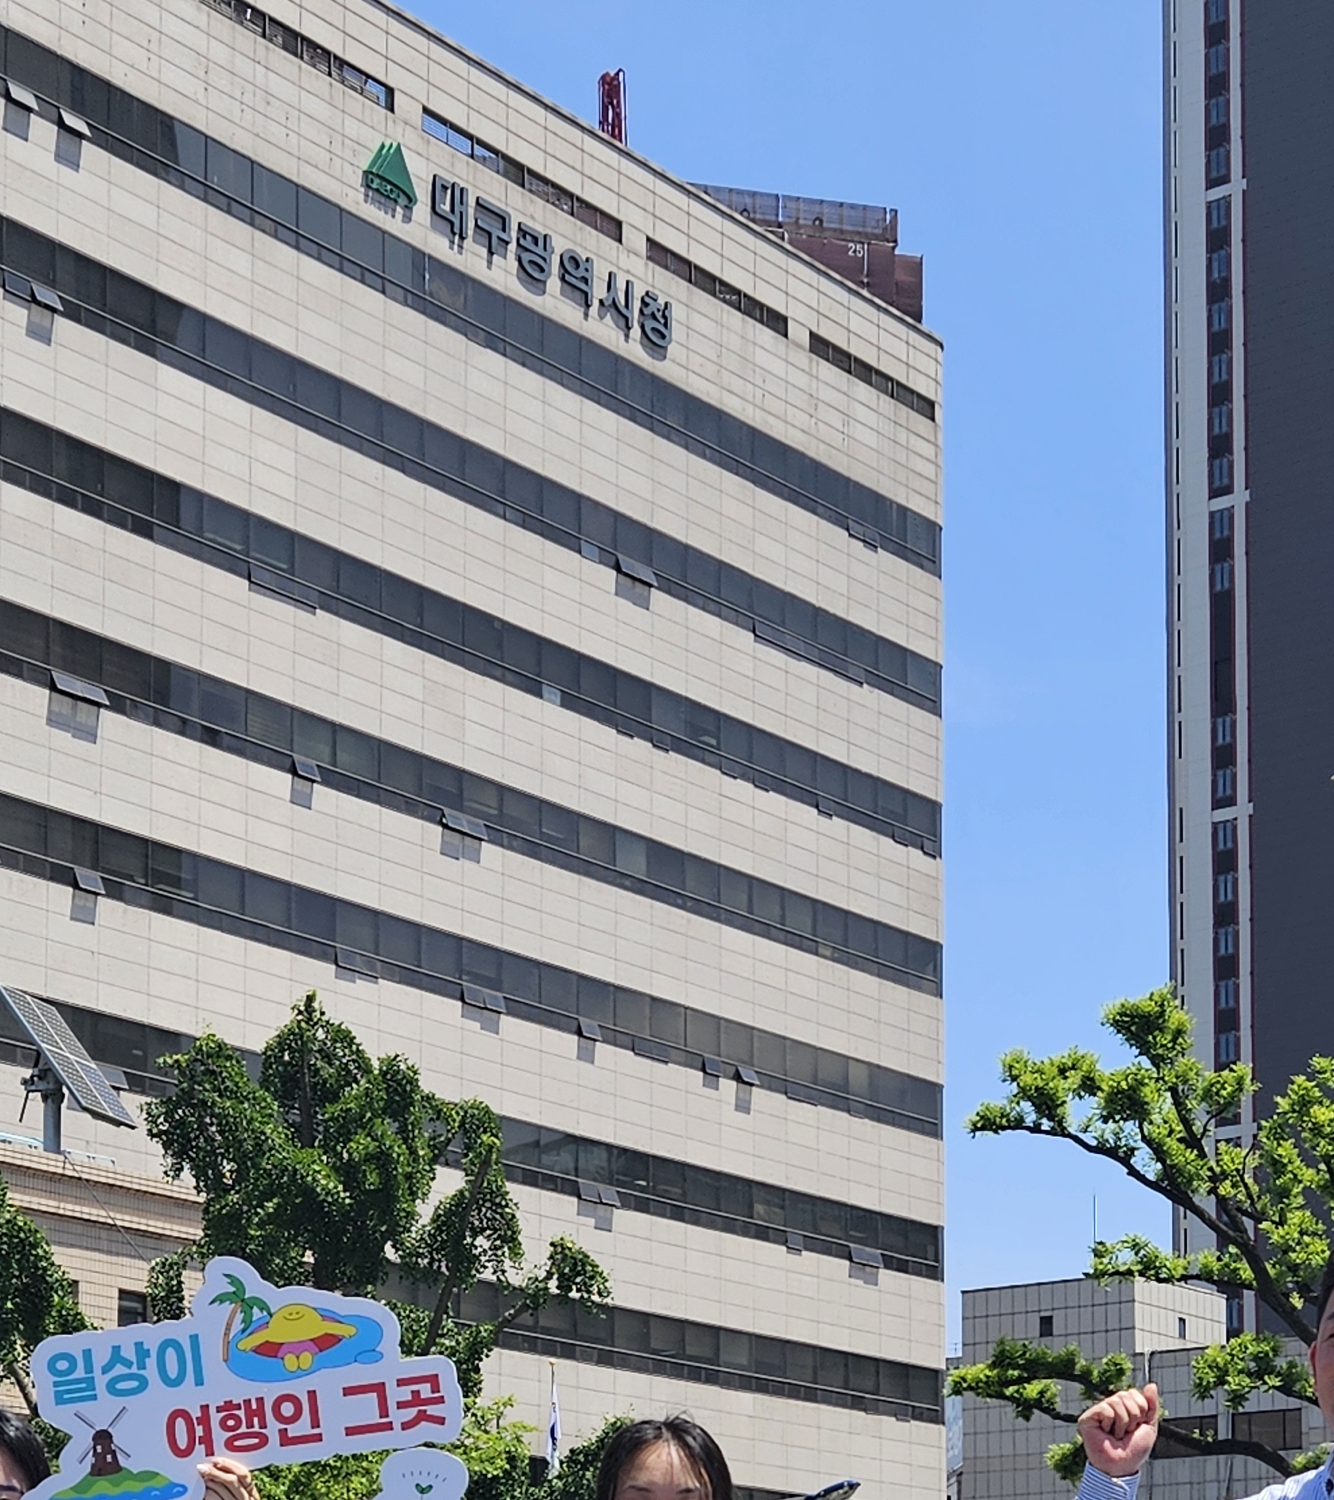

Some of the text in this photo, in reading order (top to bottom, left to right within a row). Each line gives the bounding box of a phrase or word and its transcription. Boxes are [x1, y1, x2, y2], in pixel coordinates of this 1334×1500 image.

[432, 173, 673, 348] 대구광역시청
[848, 242, 863, 257] 25
[46, 1334, 204, 1405] 일상이
[166, 1373, 447, 1460] 여행인 그곳
